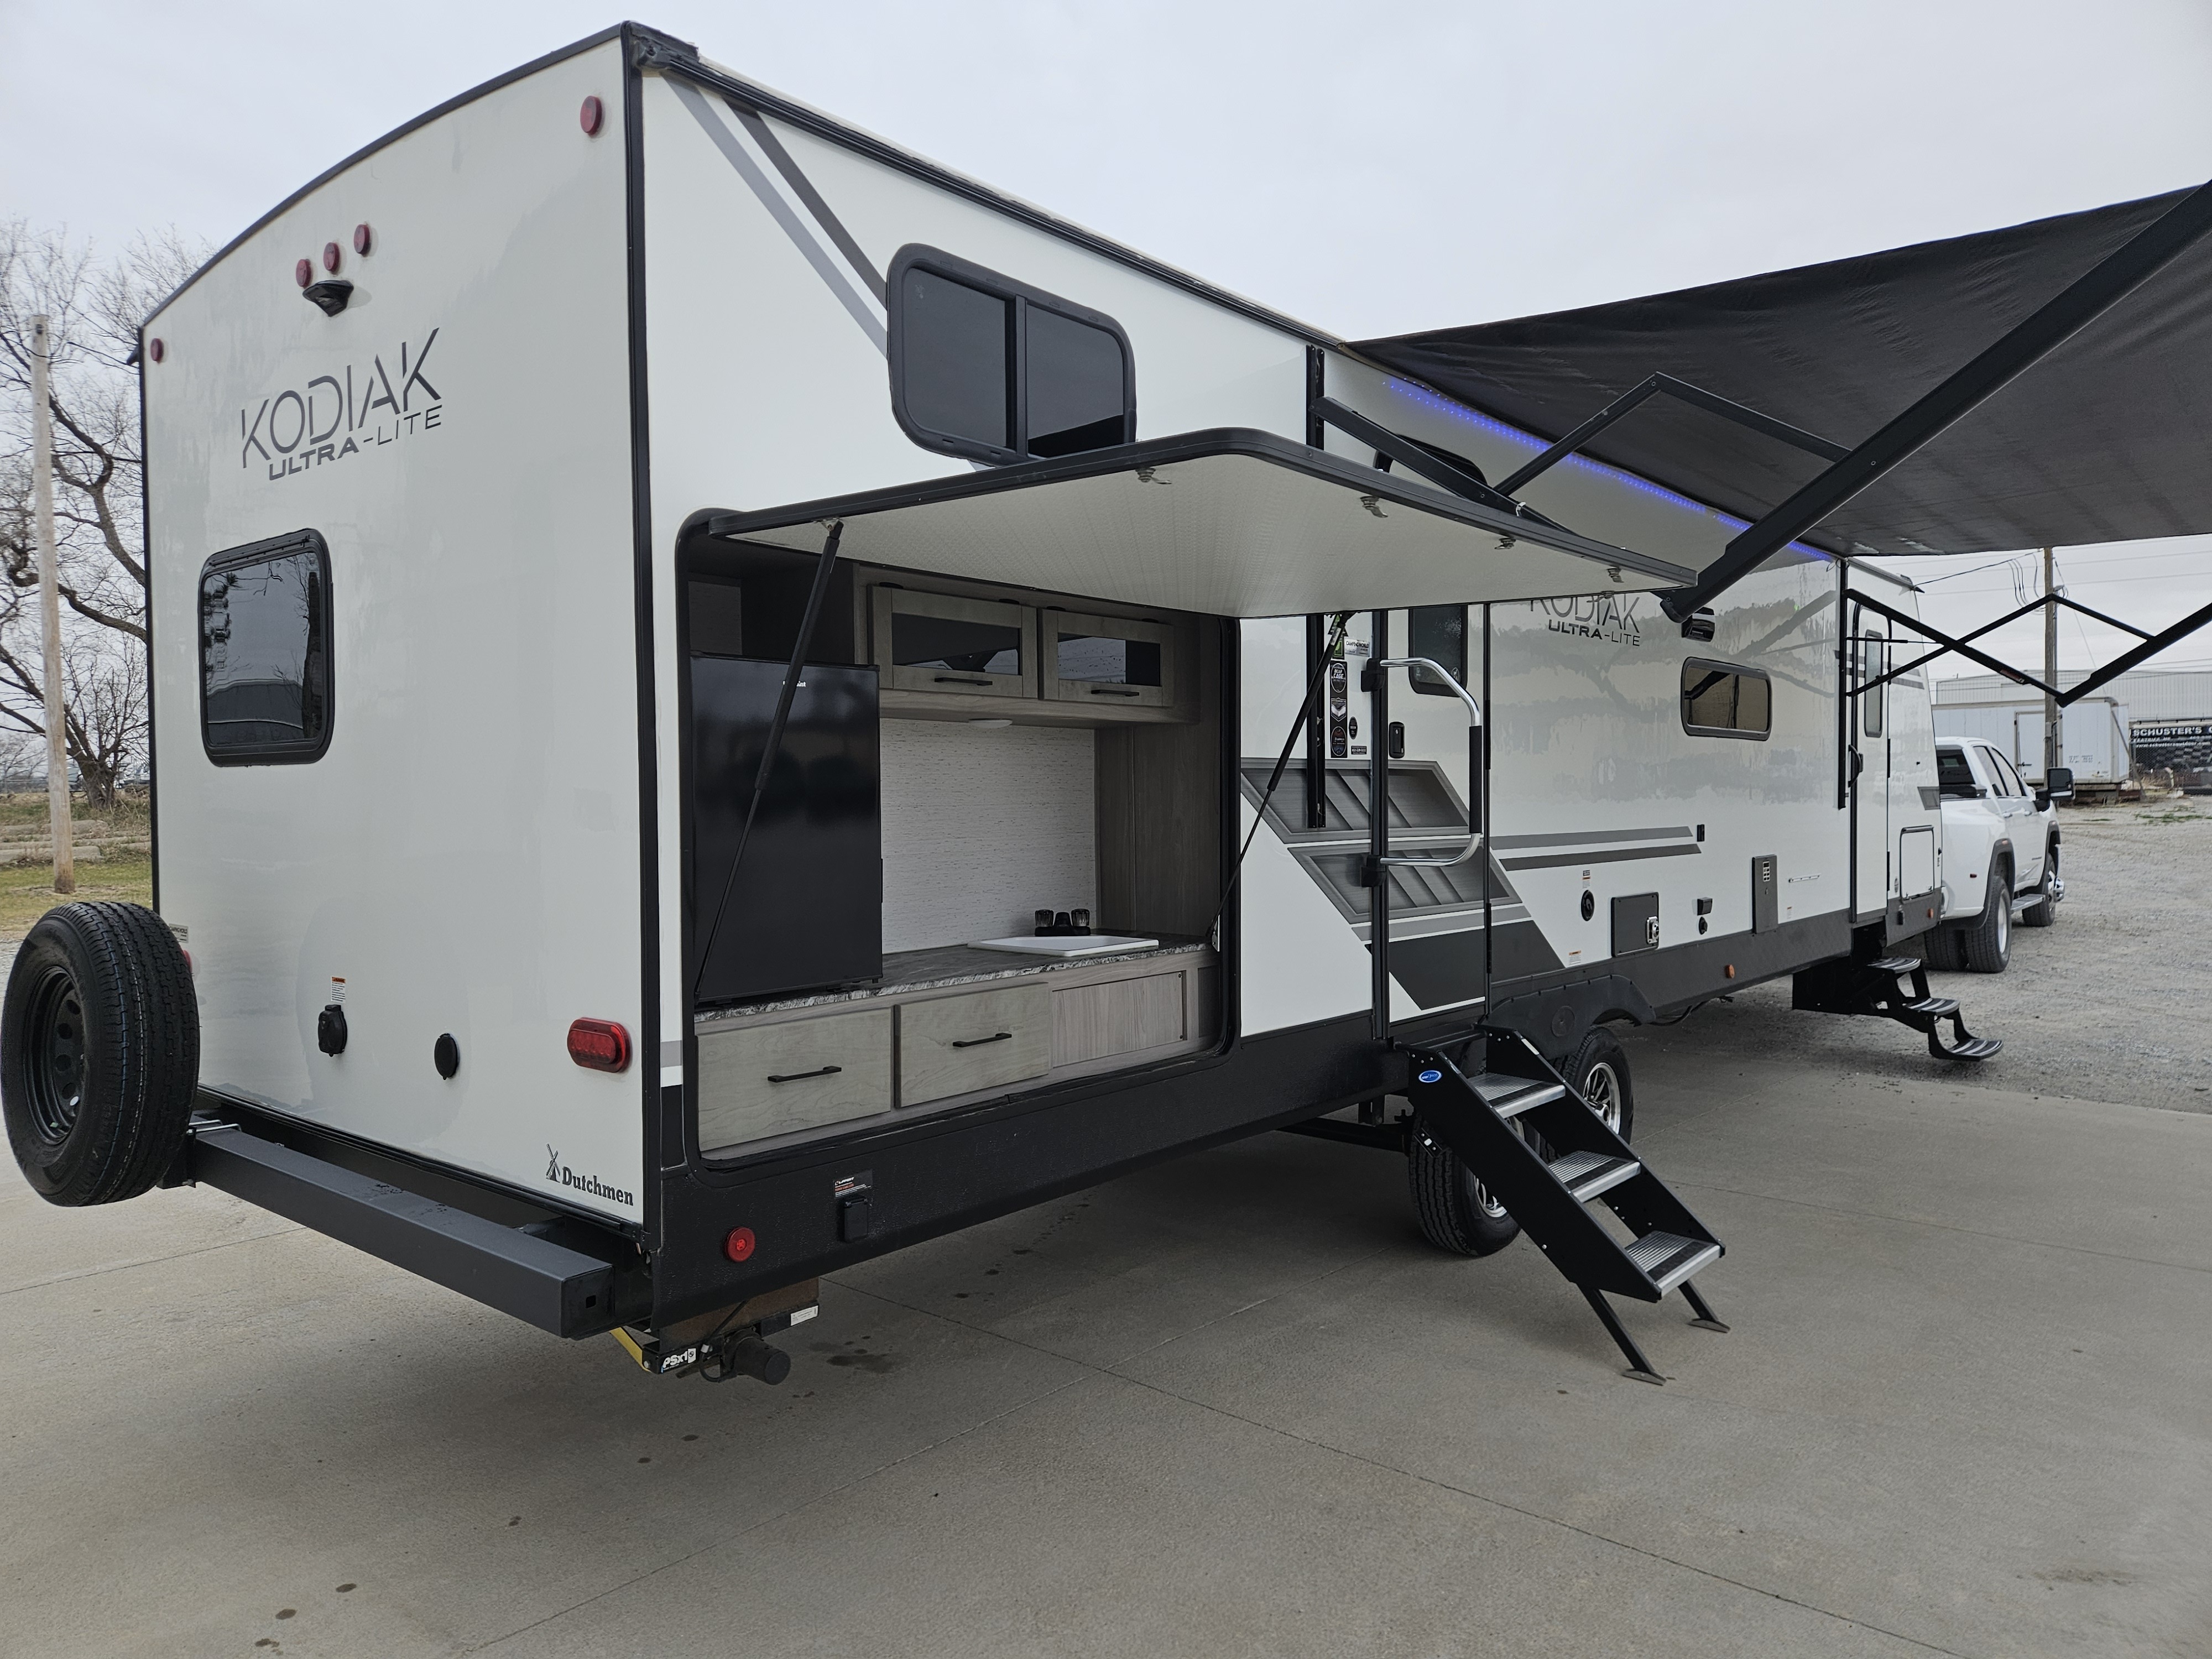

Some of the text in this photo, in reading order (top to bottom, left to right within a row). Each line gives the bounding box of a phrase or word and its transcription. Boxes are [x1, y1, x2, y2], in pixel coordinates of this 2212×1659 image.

[242, 327, 441, 468] KODIAK
[269, 405, 442, 481] ULTRA-LITE
[1548, 619, 1640, 646] ULTRA-LITE
[2133, 726, 2203, 737] SCHUSTER'S
[562, 1166, 634, 1206] Dutchmen
